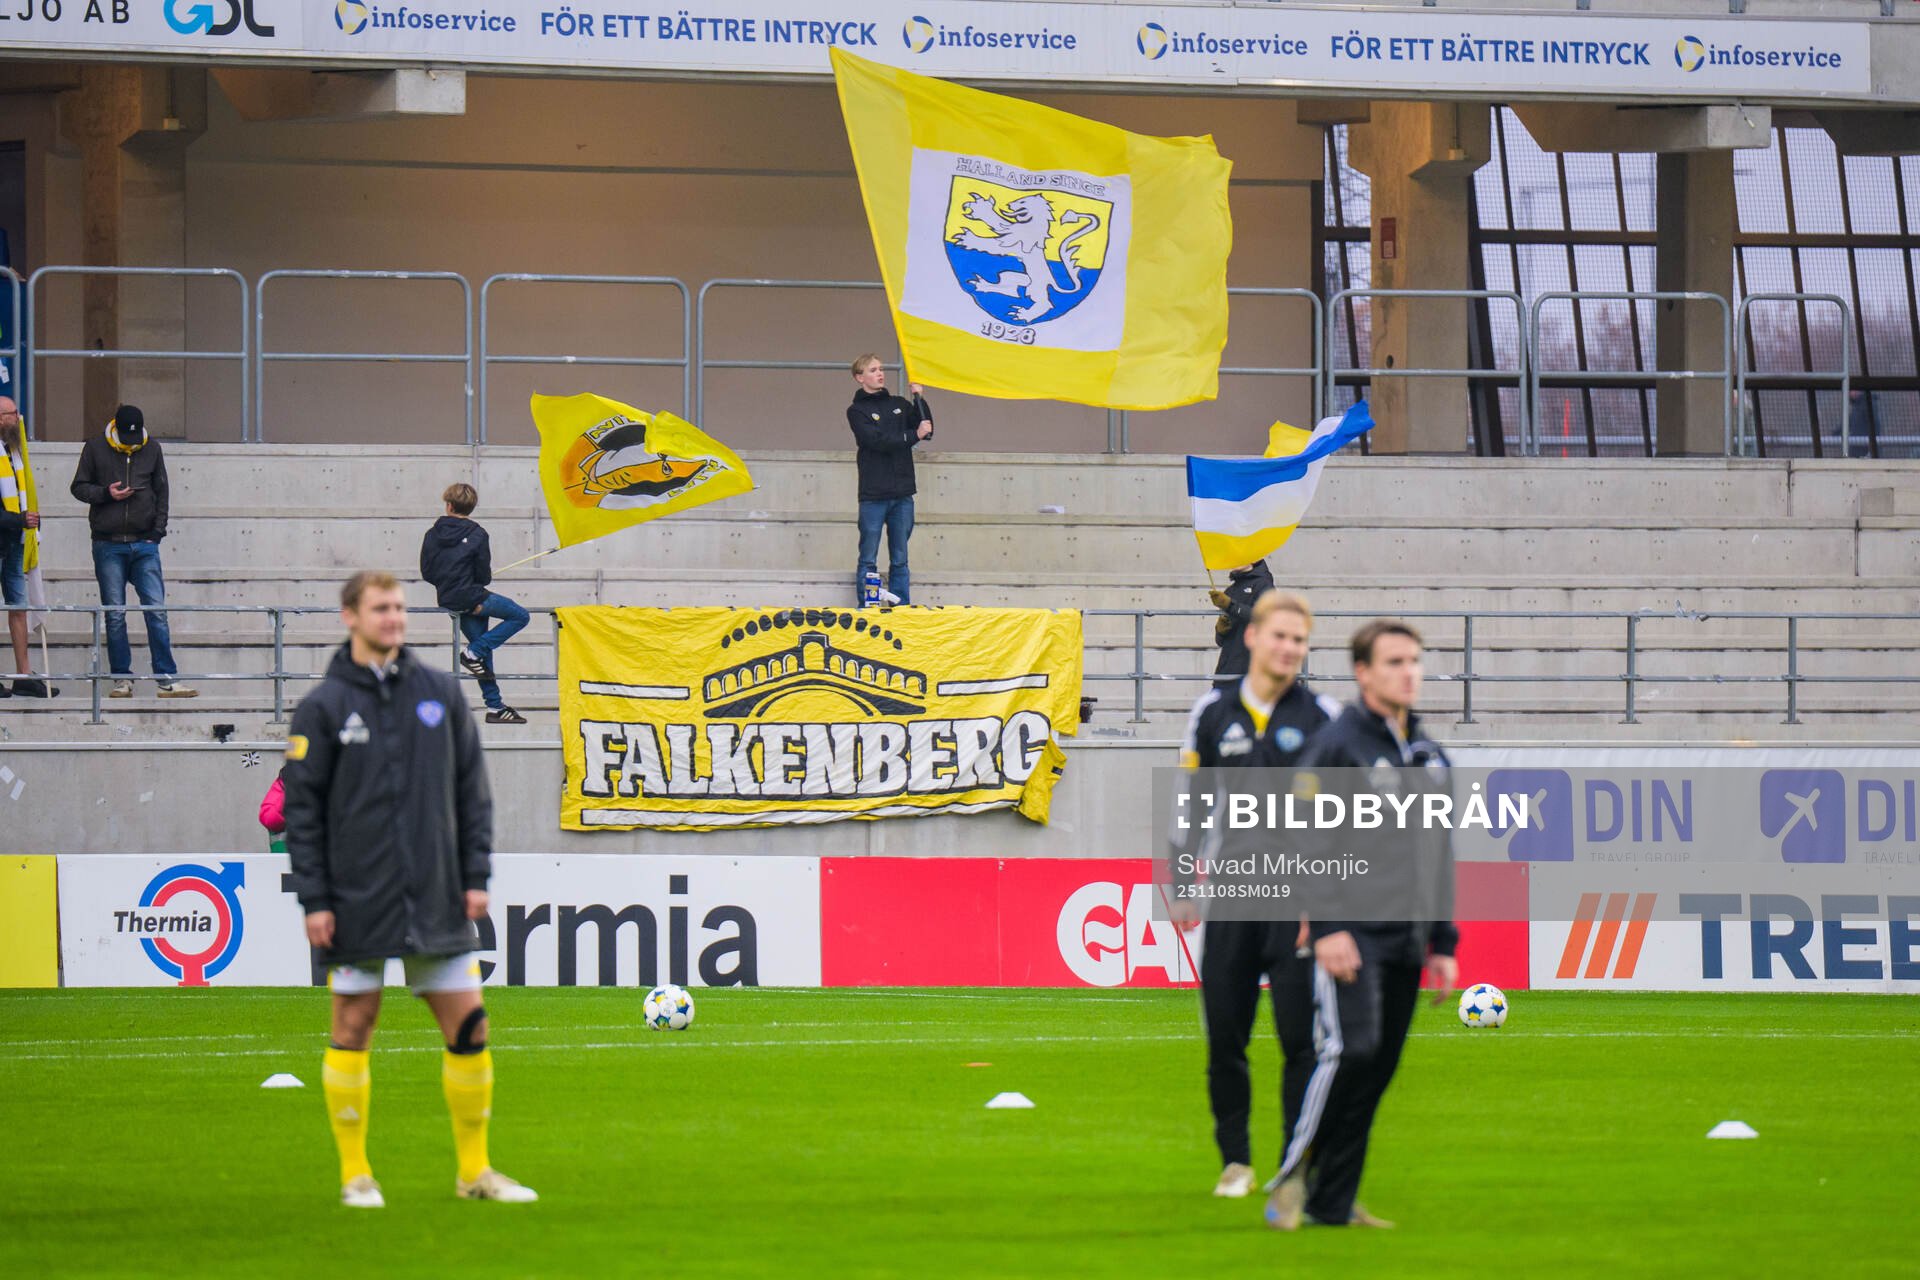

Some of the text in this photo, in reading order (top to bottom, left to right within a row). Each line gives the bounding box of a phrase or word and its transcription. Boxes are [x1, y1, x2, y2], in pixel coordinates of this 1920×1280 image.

[83, 0, 130, 24] AB
[371, 6, 516, 33] infoservice
[541, 7, 877, 46] FÖR ETT BÄTTRE INTRYCK
[939, 26, 1077, 51] infoservice
[1172, 32, 1308, 58] infoservice
[1331, 30, 1651, 67] FÖR ETT BÄTTRE INTRYCK
[1708, 44, 1842, 69] infoservice
[956, 157, 1106, 197] HALLAND SINCE
[980, 320, 1036, 345] 1928
[579, 709, 1052, 800] FALKENBERG
[1584, 779, 1694, 843] DIN
[113, 907, 212, 934] Thermia
